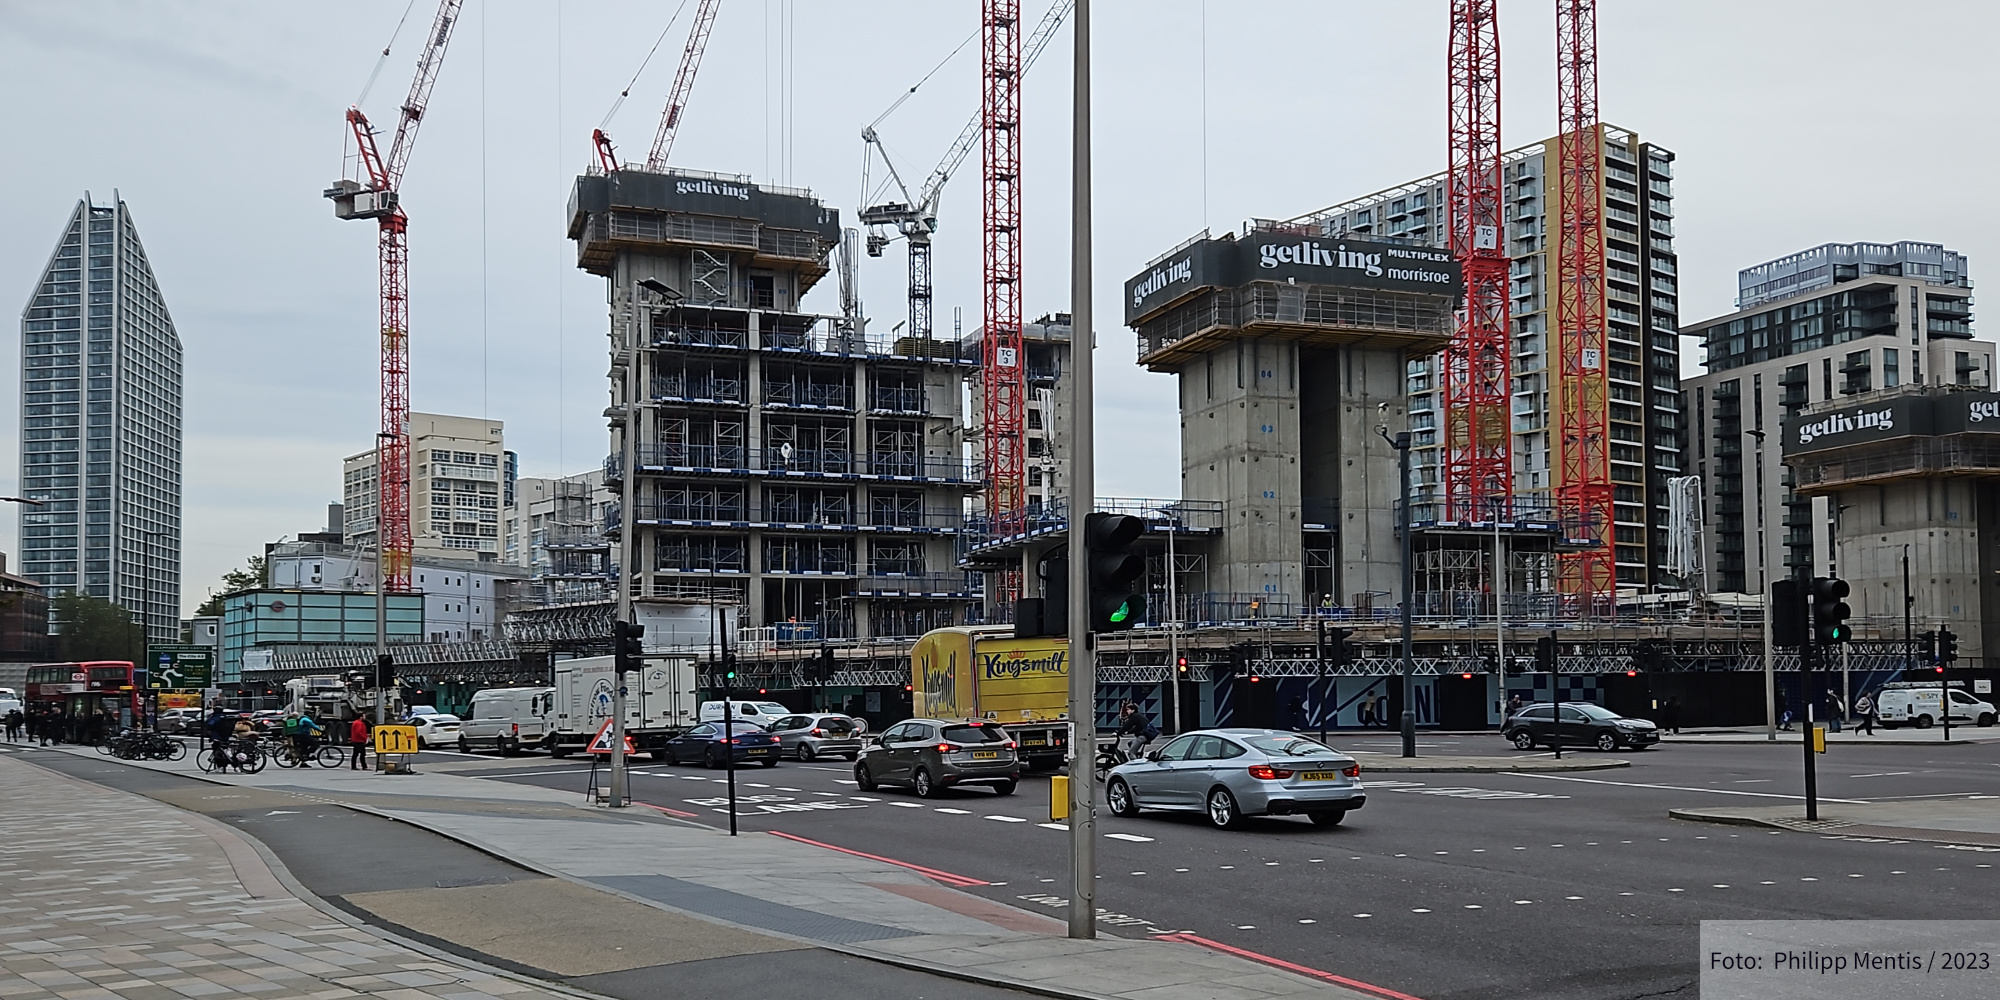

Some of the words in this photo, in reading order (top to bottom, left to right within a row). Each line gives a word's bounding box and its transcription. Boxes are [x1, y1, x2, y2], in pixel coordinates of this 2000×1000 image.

[676, 179, 749, 200] getliving
[1481, 228, 1492, 236] TC
[1259, 241, 1383, 277] getliving
[1387, 249, 1449, 263] MULTIPLEX
[1133, 255, 1191, 307] getliving
[1387, 267, 1450, 284] morrisroe
[1585, 350, 1596, 358] TC
[1261, 370, 1272, 378] 04
[1262, 425, 1274, 433] 03
[1799, 407, 1893, 444] getliving
[1263, 490, 1275, 499] 02
[1265, 584, 1277, 592] 01
[984, 651, 1069, 678] Kingsmill
